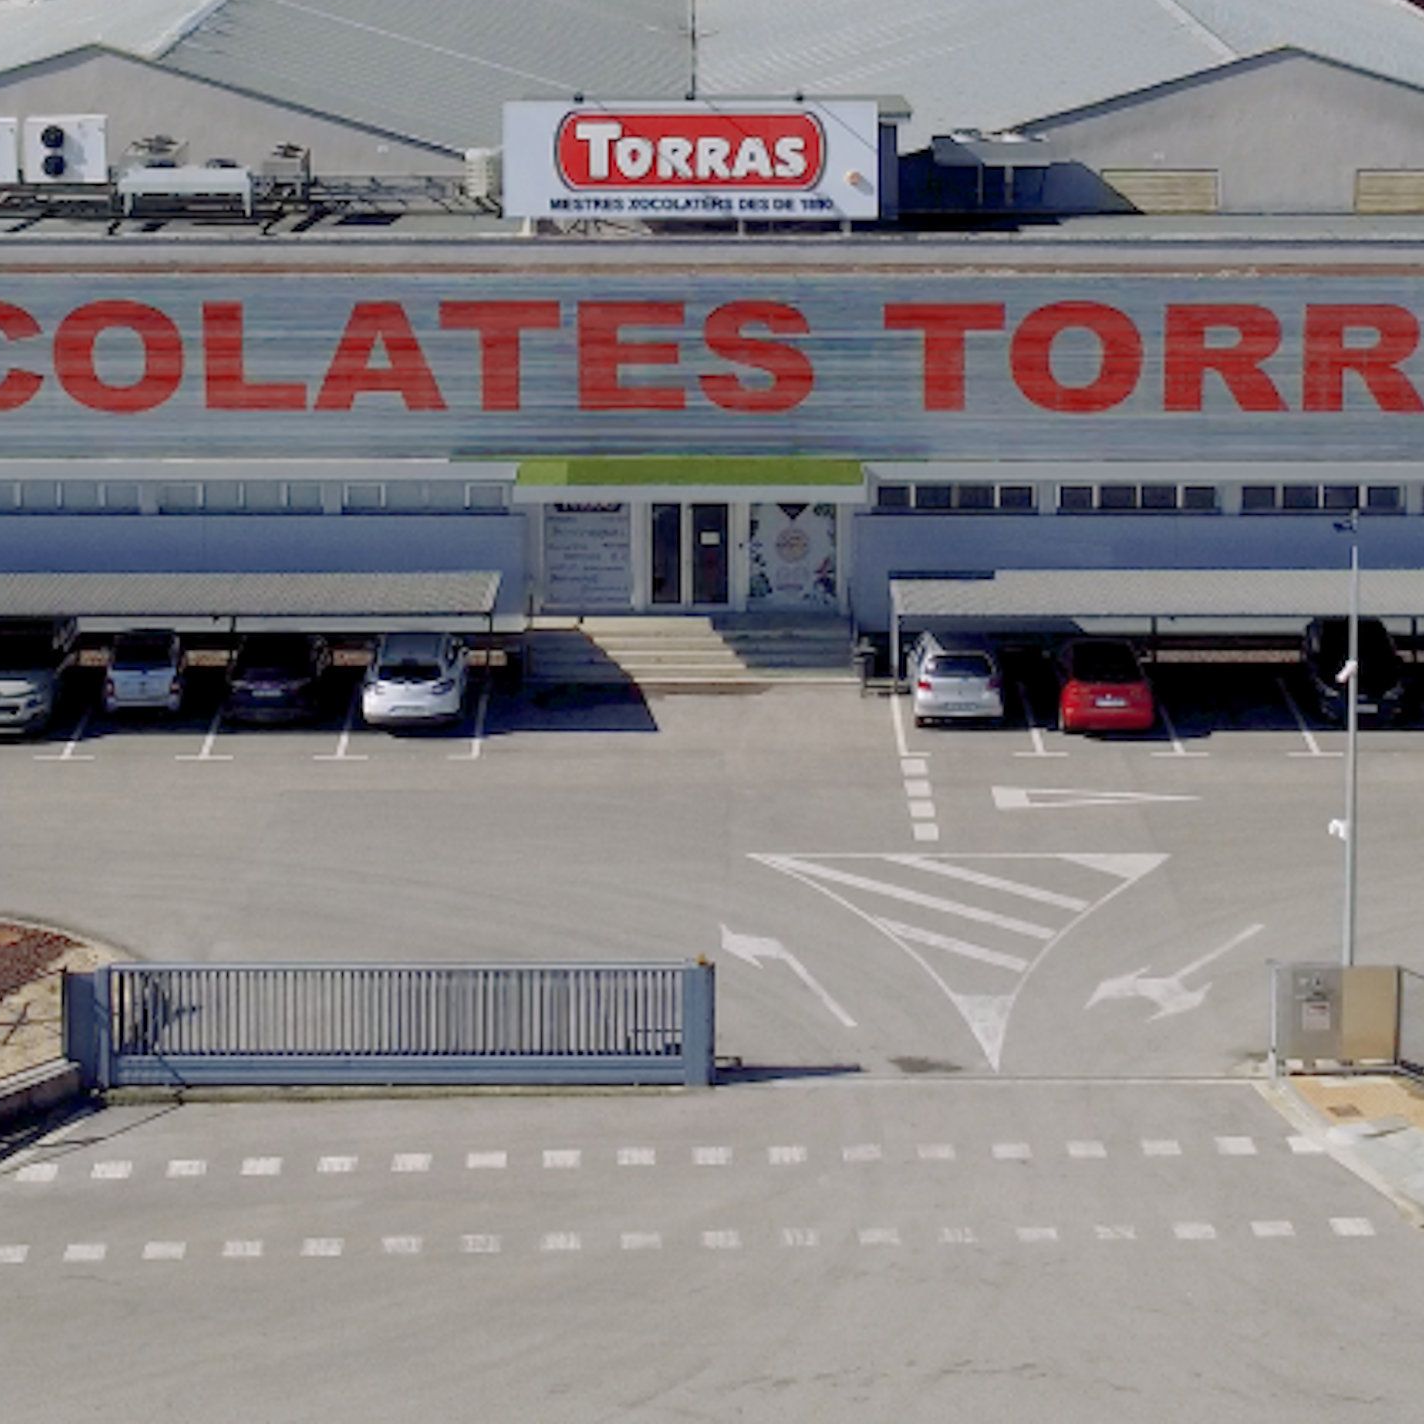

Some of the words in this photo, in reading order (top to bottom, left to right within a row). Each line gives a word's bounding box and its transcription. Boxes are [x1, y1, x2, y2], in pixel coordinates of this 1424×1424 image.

[577, 122, 807, 179] TORRAS
[549, 198, 624, 210] MESTRES
[628, 198, 733, 210] XOCOLATERS
[739, 198, 769, 210] DES
[773, 198, 794, 210] DE
